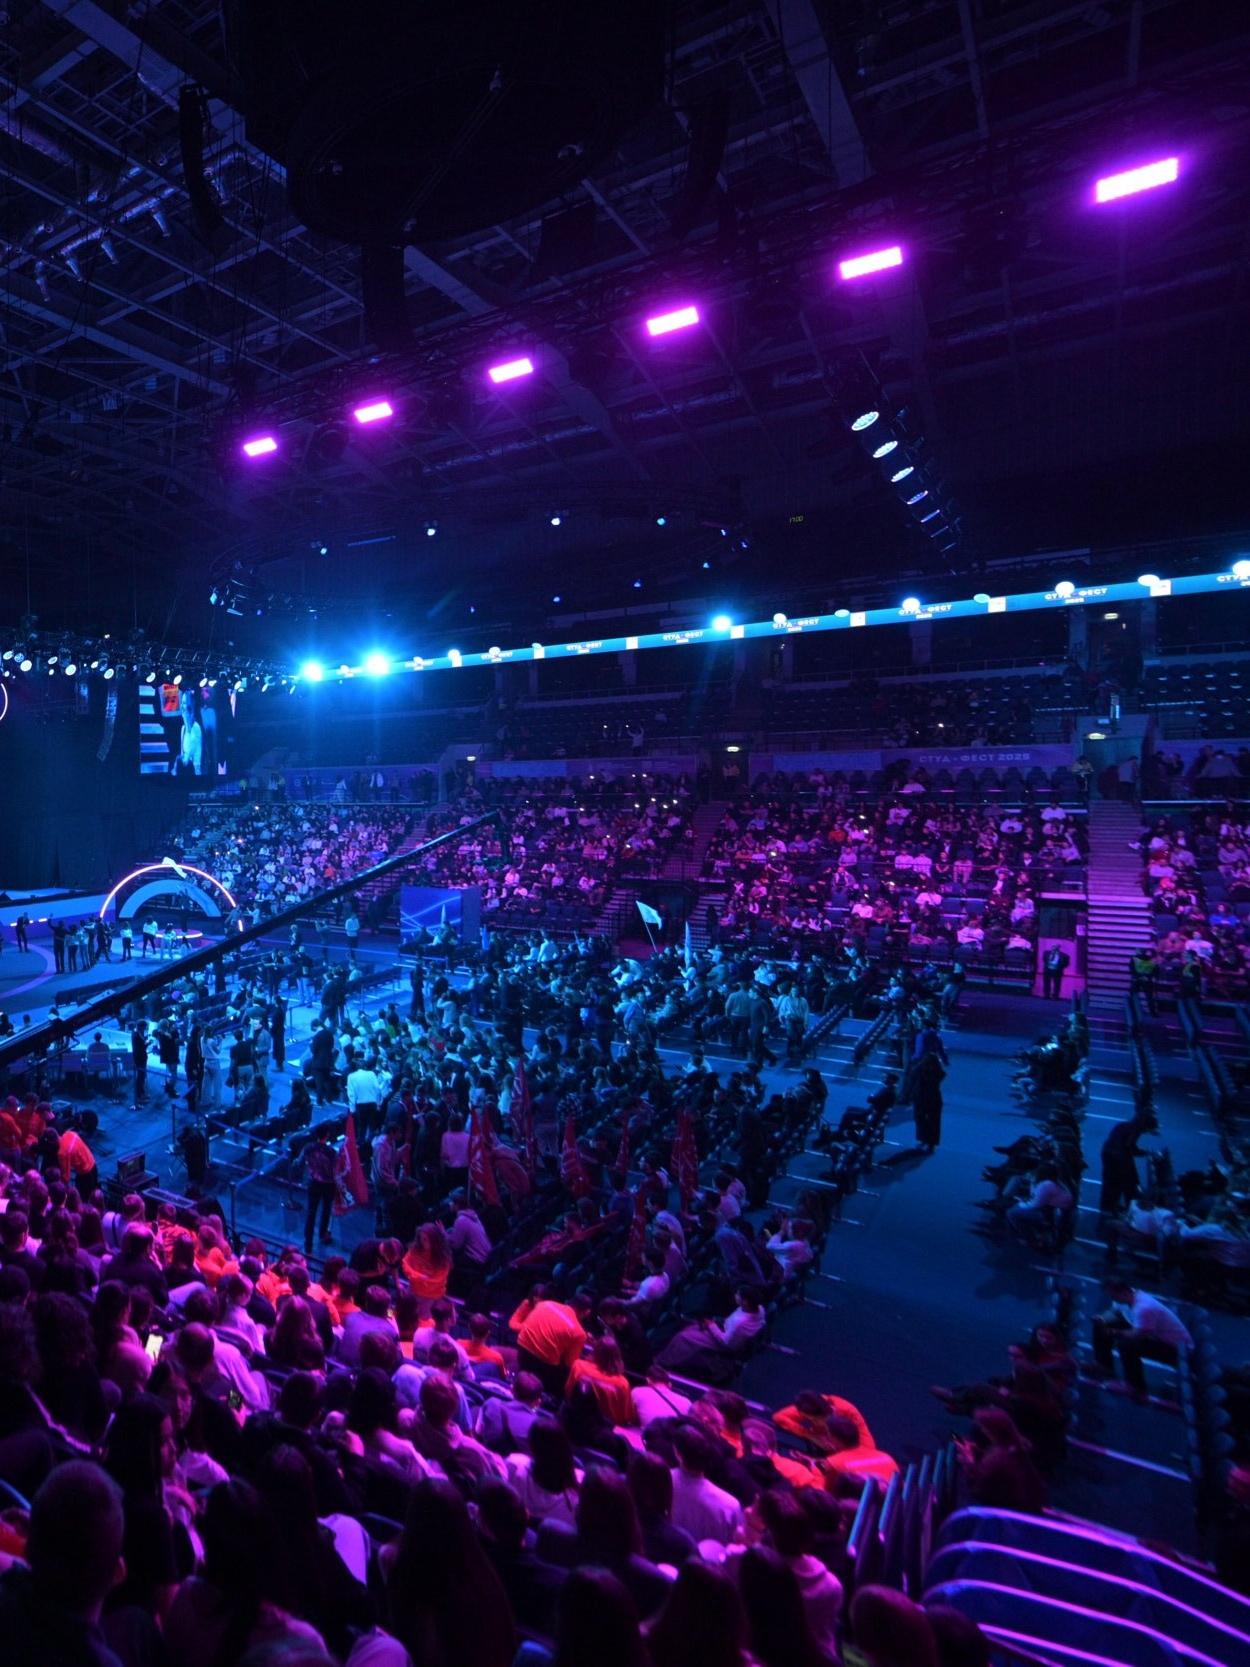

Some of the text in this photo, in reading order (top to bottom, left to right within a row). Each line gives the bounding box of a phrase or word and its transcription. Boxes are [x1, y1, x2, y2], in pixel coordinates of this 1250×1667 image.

[919, 753, 1031, 763] СТУД ФЕСТ 2025
